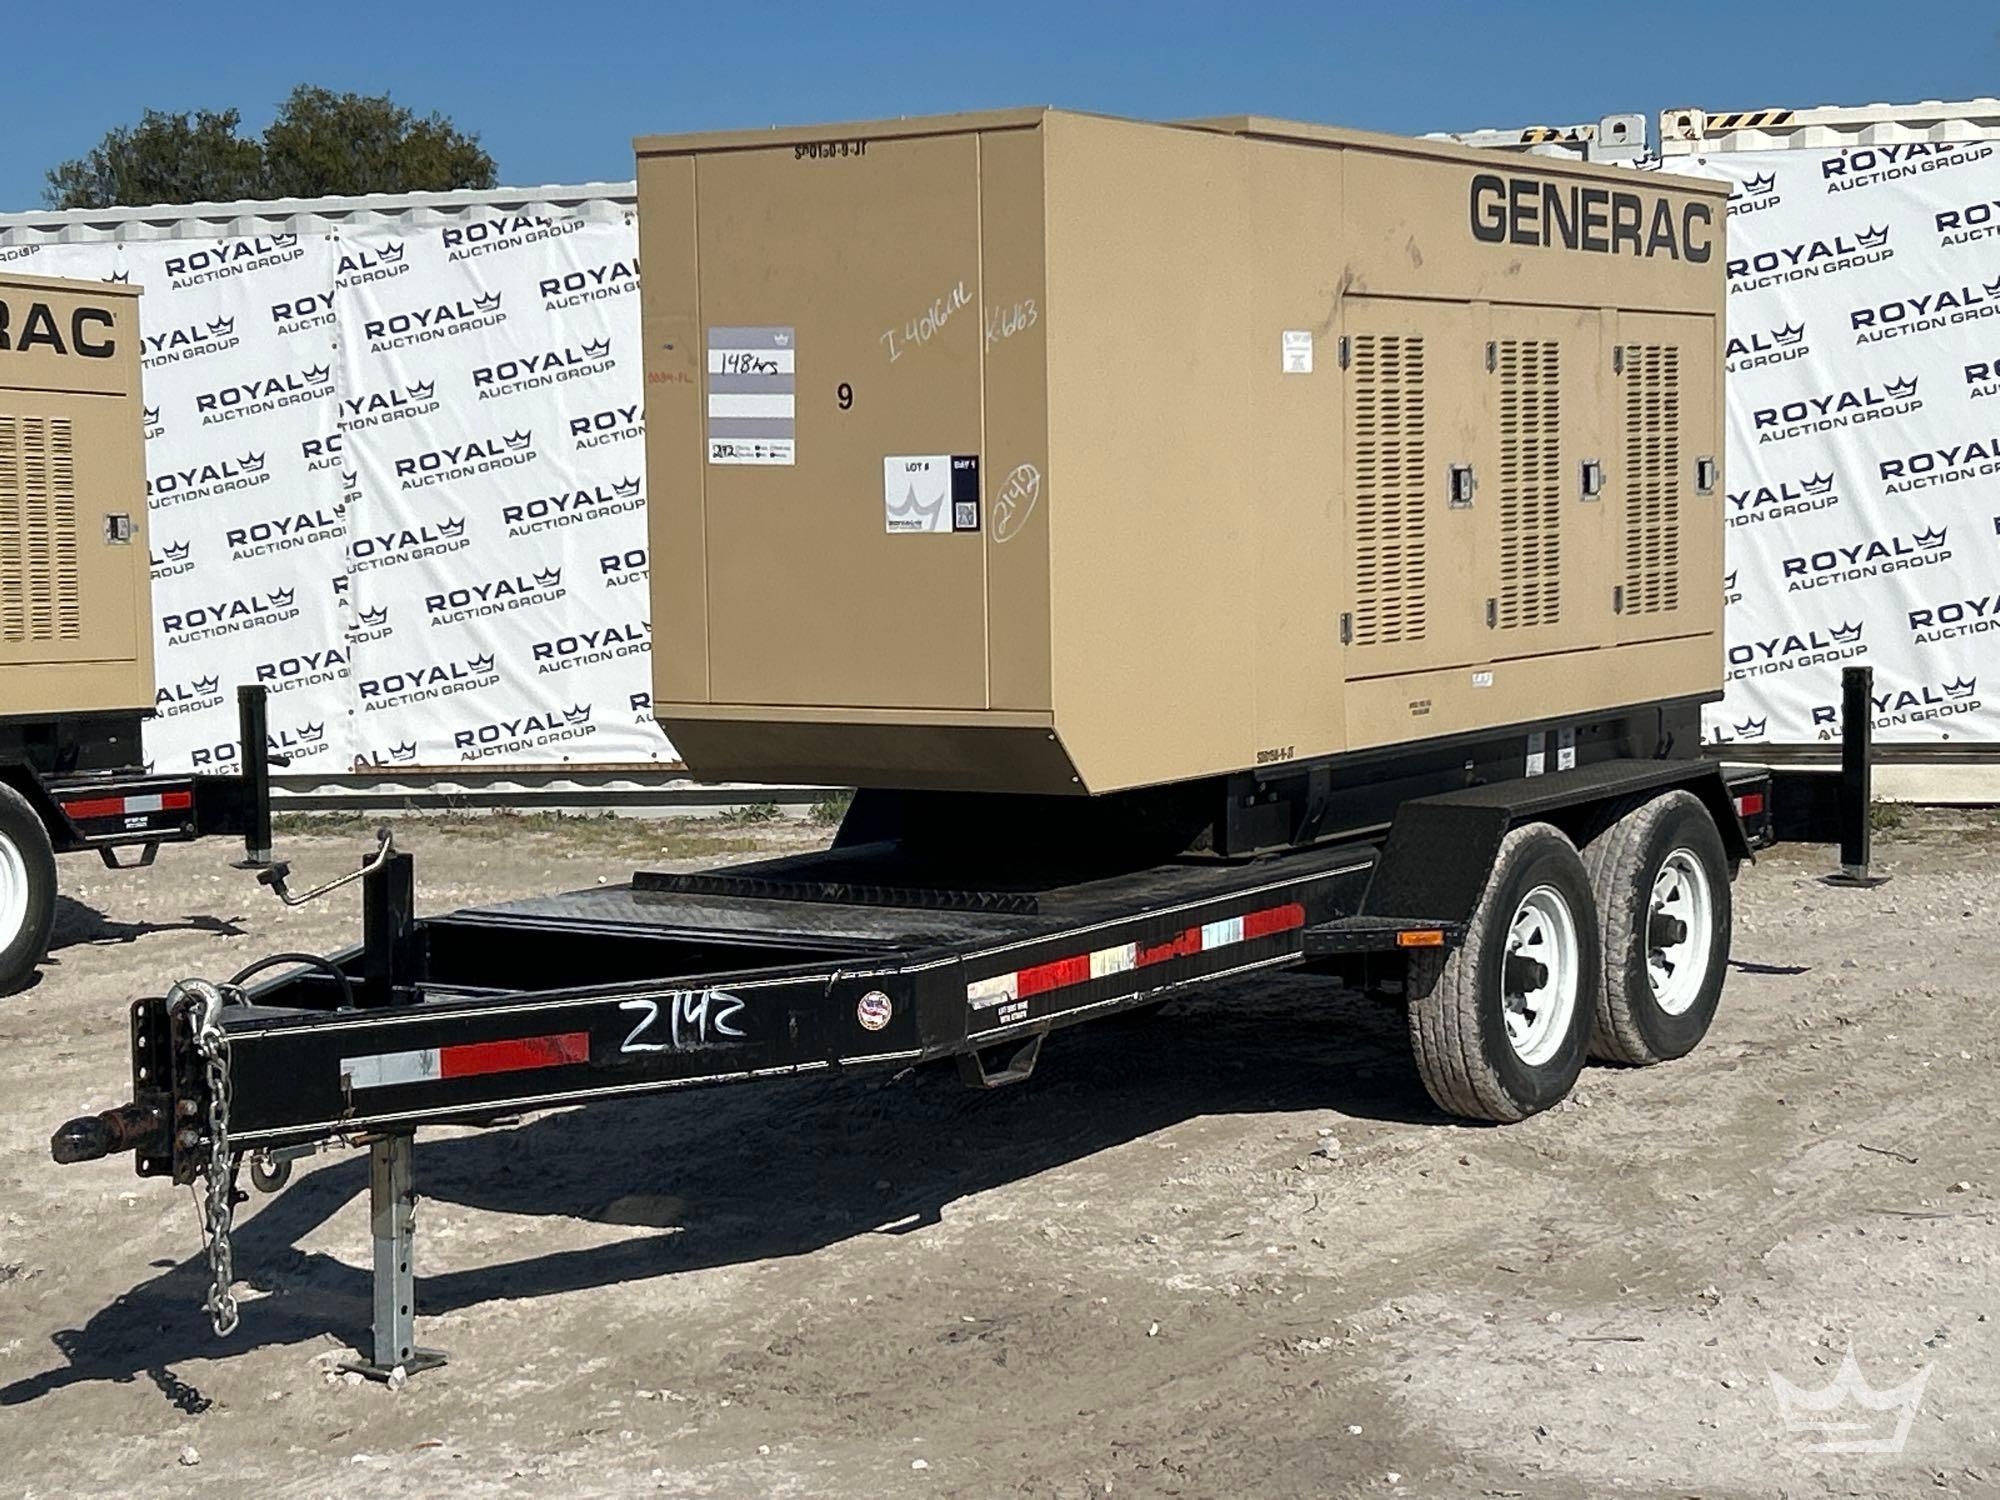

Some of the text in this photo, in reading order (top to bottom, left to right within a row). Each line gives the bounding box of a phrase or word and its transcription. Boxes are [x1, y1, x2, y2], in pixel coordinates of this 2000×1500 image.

[1827, 147, 1993, 194] AUCTION GROUP
[1471, 174, 1711, 263] GENERAC
[1727, 196, 1781, 217] ROUP
[0, 244, 40, 262] ROUP
[448, 220, 585, 263] AUCTION GROUP
[1941, 227, 2000, 248] AUCT
[165, 236, 273, 277] ROYAL
[171, 248, 304, 291] AUCTION GROUP
[351, 263, 409, 287] GROUP
[1727, 237, 1855, 279] ROYAL
[1730, 249, 1894, 295] AUCTION GROUP
[272, 290, 335, 322] ROY
[545, 285, 621, 311] AUCTION
[1851, 287, 1983, 330] ROYAL
[277, 313, 336, 336] AUCTIO
[364, 301, 475, 340] ROYAL
[370, 313, 506, 353] AUCTION GROUP
[1856, 306, 2000, 345] AUCTION GRO
[140, 325, 208, 355] YAL
[142, 337, 240, 369] TION GROUP
[472, 348, 582, 387] ROYAL
[1740, 346, 1809, 373] GROUP
[196, 374, 304, 412] ROYAL
[478, 359, 615, 400] AUCTION GROUP
[837, 383, 853, 410] 9
[202, 385, 335, 426] AUCTION GROUP
[337, 401, 440, 433] TION GROUP
[339, 389, 408, 417] YAL
[570, 405, 646, 436] ROY
[1754, 387, 1884, 430] ROYAL
[1759, 400, 1923, 444] AUCTION GROUP
[395, 439, 504, 477] ROYAL
[401, 451, 536, 490] AUCTION GROUP
[906, 462, 922, 472] LOT
[149, 473, 270, 507] UCTION GROUP
[1727, 483, 1801, 511] YAL
[1885, 467, 1975, 495] AUCTION
[503, 486, 612, 525] ROYAL
[508, 498, 646, 538] AUCTION GROUP
[1769, 496, 1839, 519] GROUP
[227, 510, 334, 548] ROYAL
[232, 525, 347, 561] AUCTION GRO
[151, 562, 194, 580] ROUP
[347, 538, 470, 574] UCTION GROUP
[1783, 537, 1913, 578] ROYAL
[1788, 550, 1952, 592] AUCTION GROUP
[425, 576, 534, 613] ROYAL
[606, 570, 649, 588] AUCT
[163, 596, 269, 634] ROYAL
[431, 588, 566, 627] AUCTION GROUP
[1908, 595, 2000, 630] ROY
[168, 608, 299, 647] AUCTION GROUP
[351, 627, 393, 645] ROUP
[532, 624, 643, 660] ROYAL
[1914, 619, 2000, 644] AUCTION
[538, 641, 651, 675] AUCTION GRO
[1727, 645, 1867, 682] UCTION GROUP
[1728, 631, 1830, 665] OYAL
[358, 662, 468, 699] ROYAL
[365, 675, 500, 712] AUCTION GROUP
[168, 696, 224, 717] GROUP
[1812, 686, 1942, 725] RYAL
[1911, 700, 1981, 721] GROUP
[192, 729, 297, 767] ROAL
[454, 712, 564, 749] ROYAL
[460, 724, 596, 762] AUCTION GROUP
[269, 743, 329, 761] ROUP
[618, 990, 746, 1054] 2142
